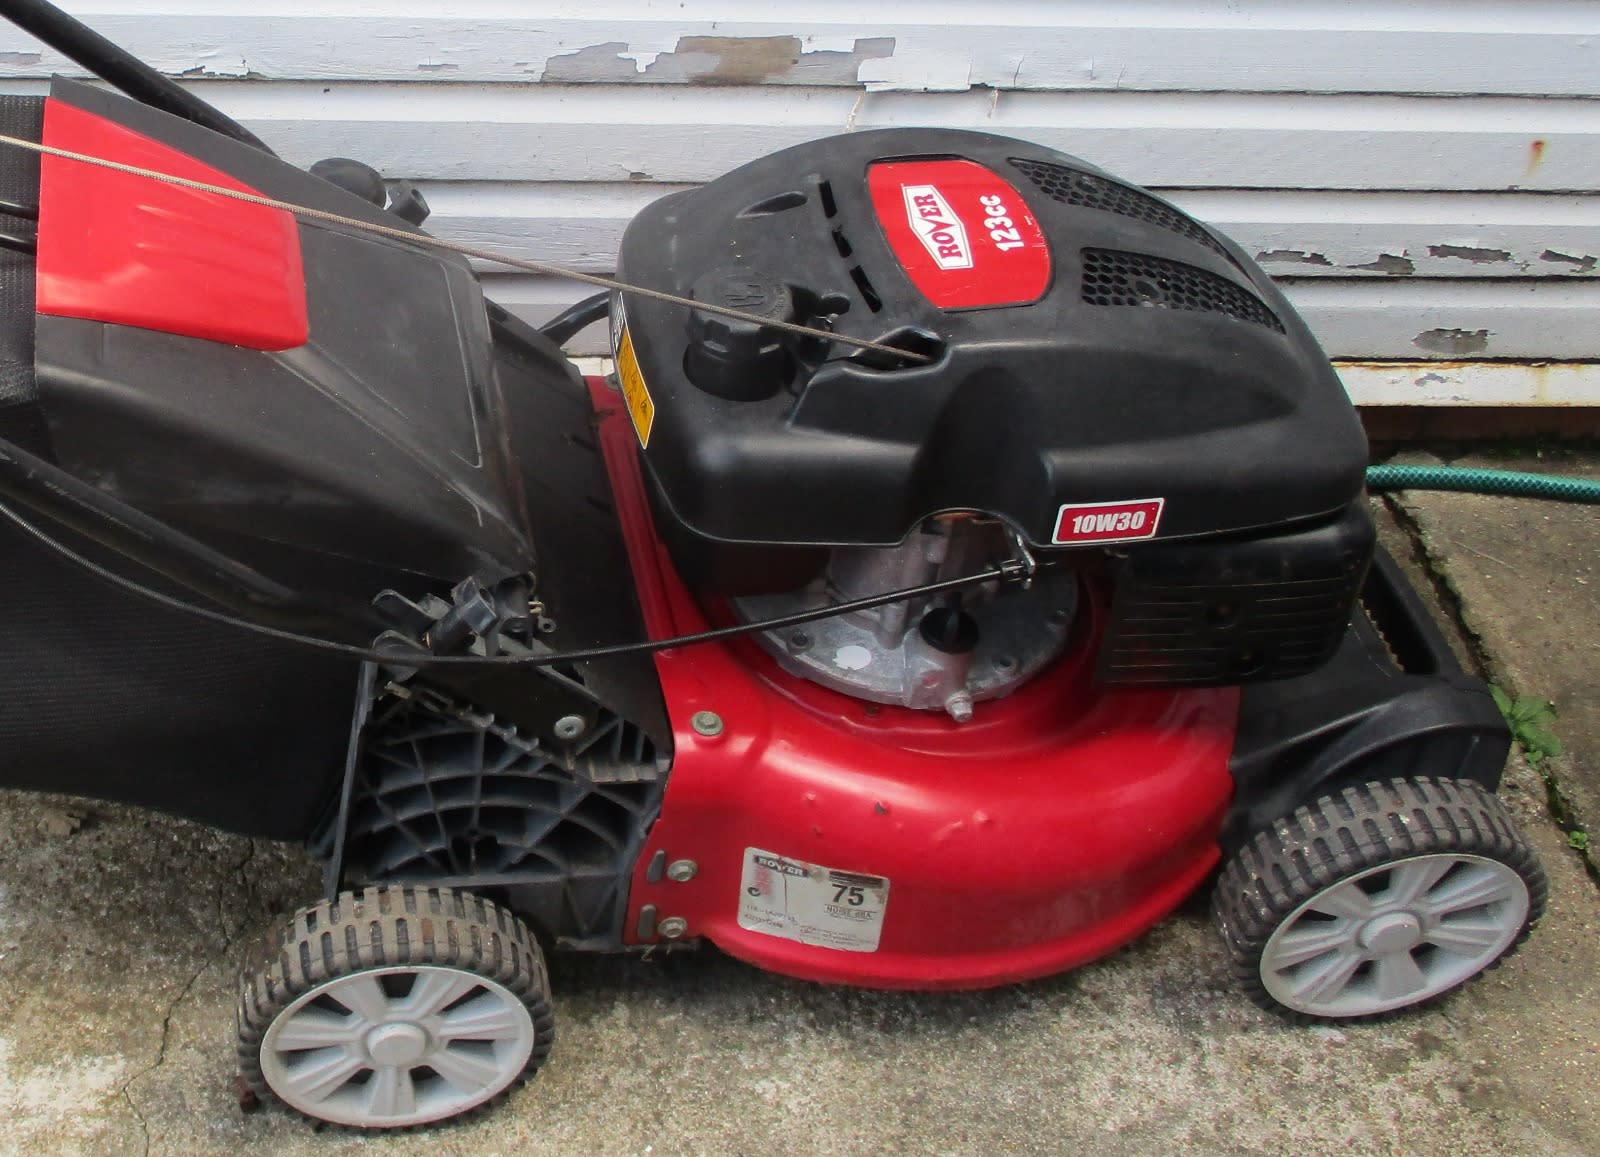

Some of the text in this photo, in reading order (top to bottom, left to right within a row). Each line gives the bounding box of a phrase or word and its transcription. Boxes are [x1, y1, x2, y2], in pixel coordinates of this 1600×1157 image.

[913, 193, 963, 259] ROVER
[979, 194, 1025, 252] 123cc
[1072, 511, 1146, 534] 10W30
[832, 883, 865, 906] 75
